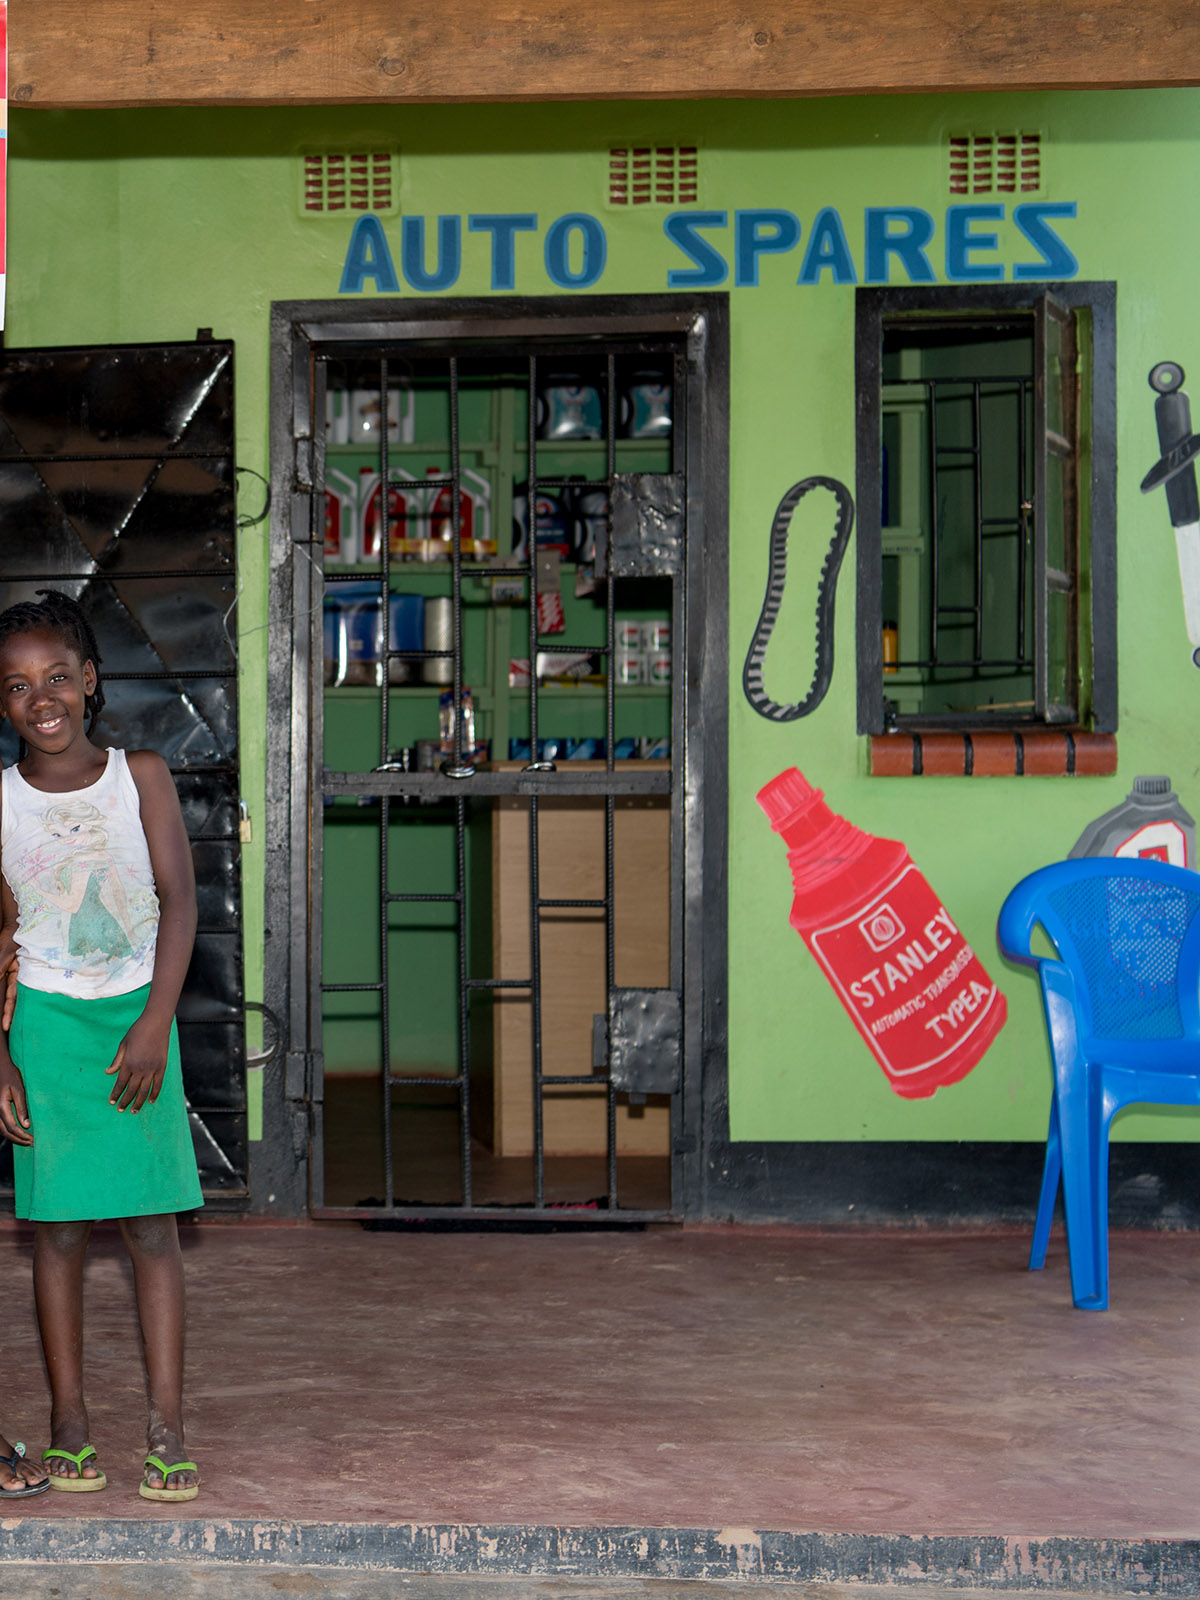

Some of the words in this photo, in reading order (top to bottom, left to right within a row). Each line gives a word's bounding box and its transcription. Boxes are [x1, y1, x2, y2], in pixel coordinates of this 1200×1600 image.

[338, 212, 608, 293] AUTO
[663, 202, 1080, 288] SPARES
[850, 907, 958, 1008] STANLEY
[871, 994, 927, 1036] AUTOMATIC
